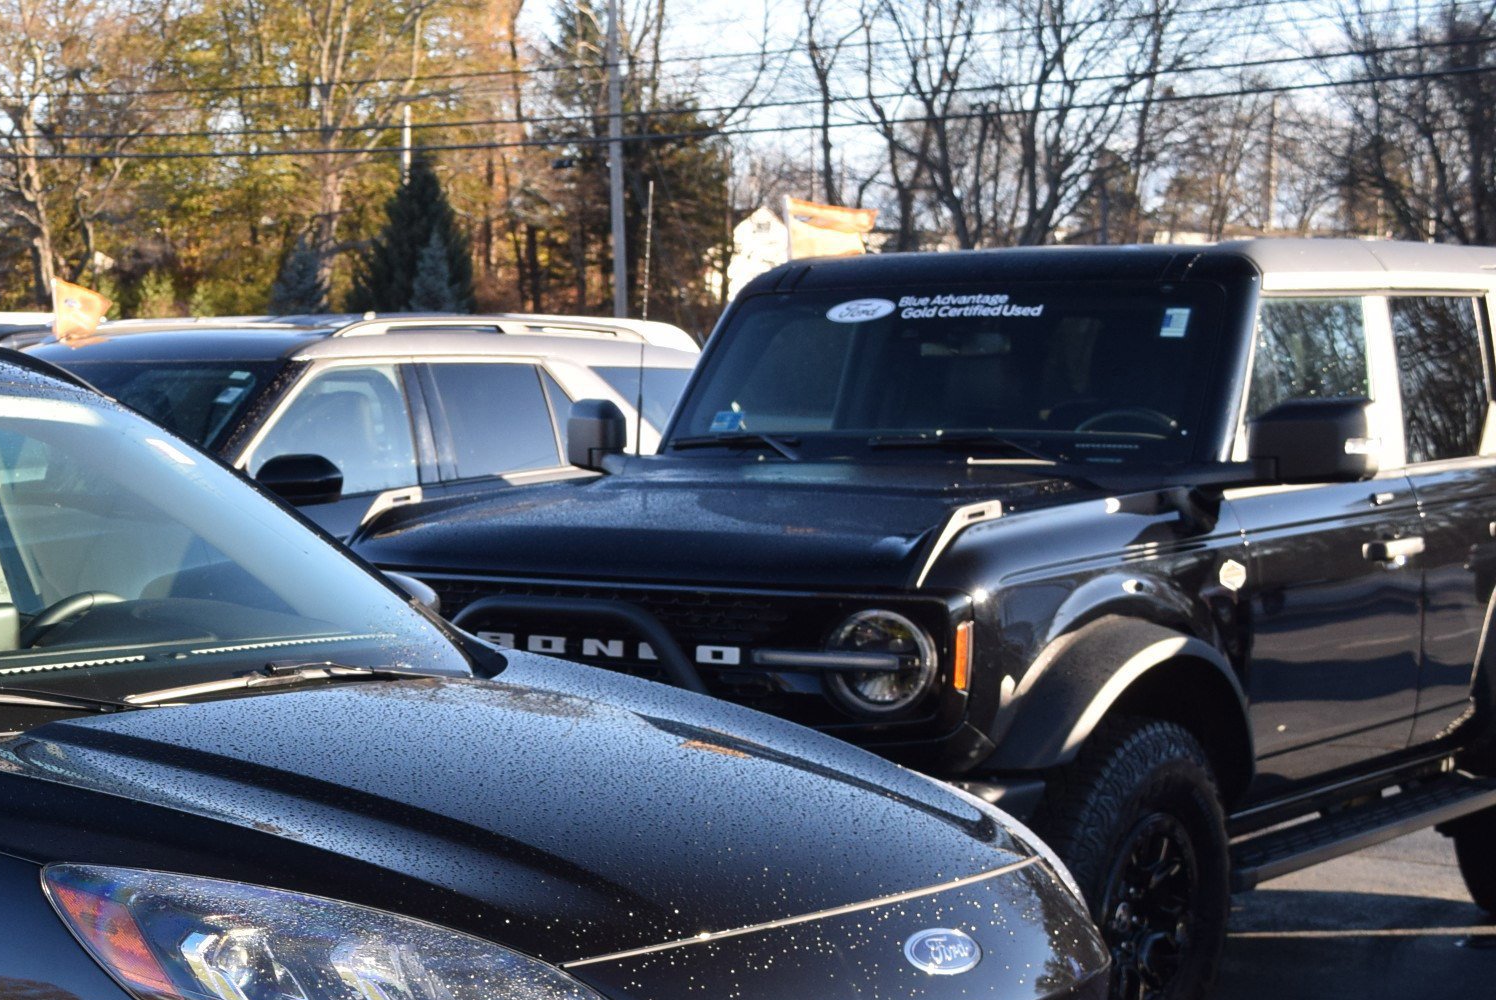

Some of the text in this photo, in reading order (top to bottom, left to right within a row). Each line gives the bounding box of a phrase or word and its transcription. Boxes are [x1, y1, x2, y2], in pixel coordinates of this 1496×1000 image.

[898, 294, 1009, 307] Blue Advantage
[901, 304, 1044, 319] Gold Certified Used
